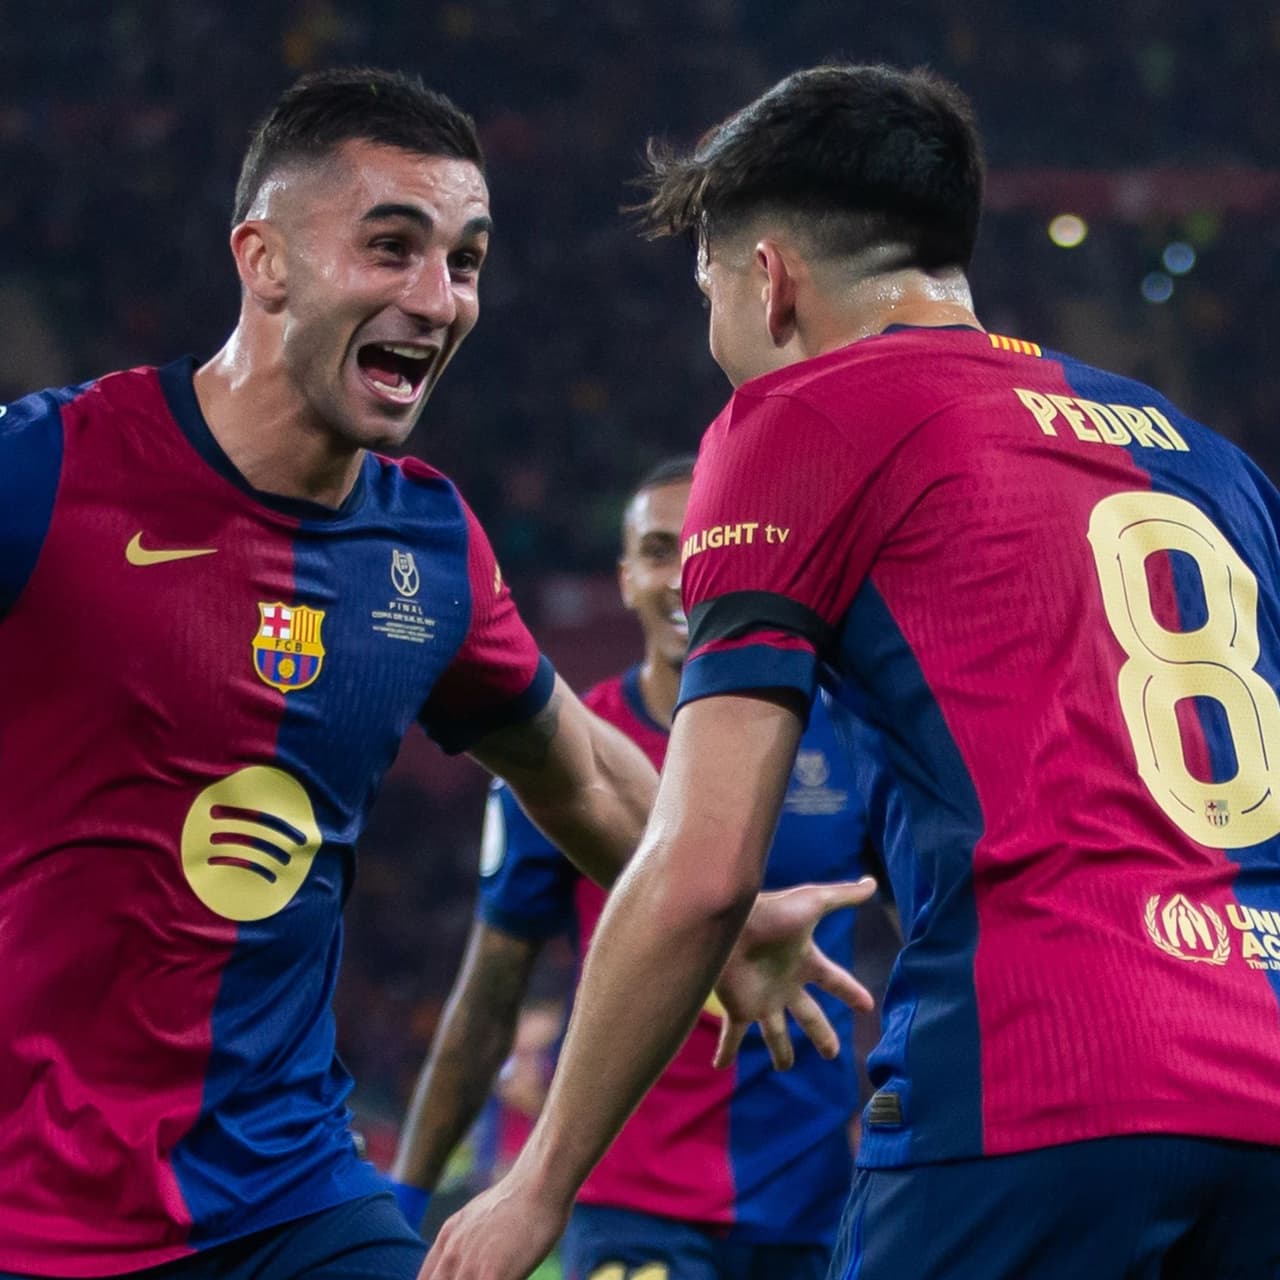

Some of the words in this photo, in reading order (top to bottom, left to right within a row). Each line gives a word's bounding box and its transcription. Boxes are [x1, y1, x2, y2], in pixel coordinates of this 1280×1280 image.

[1013, 387, 1191, 452] PEDRI
[765, 524, 790, 543] tv
[389, 601, 423, 616] FINAL
[1246, 959, 1269, 970] The
